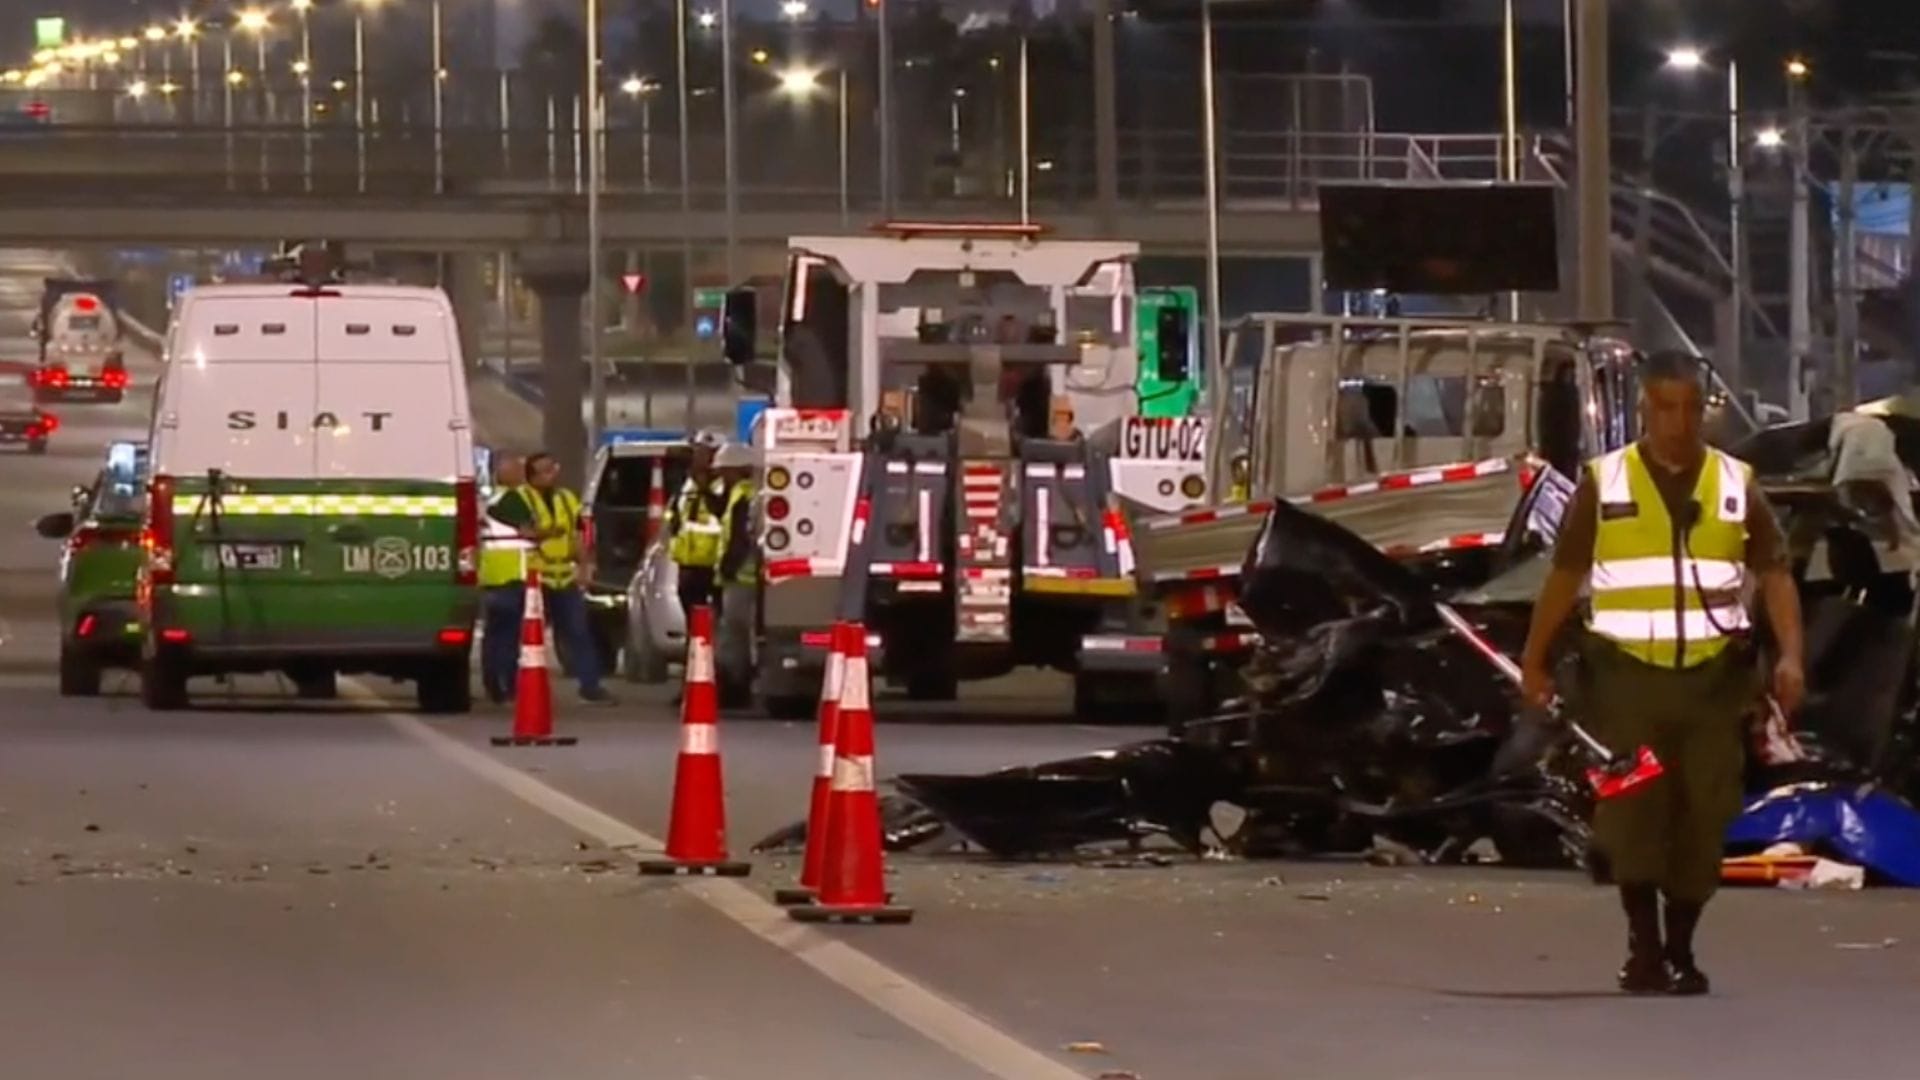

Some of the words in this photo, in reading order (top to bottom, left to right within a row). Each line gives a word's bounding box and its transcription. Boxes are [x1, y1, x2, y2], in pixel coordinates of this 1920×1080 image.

[227, 410, 393, 431] SIAT
[1126, 416, 1202, 460] GTU-02
[343, 545, 370, 572] LM
[413, 545, 450, 571] 103
